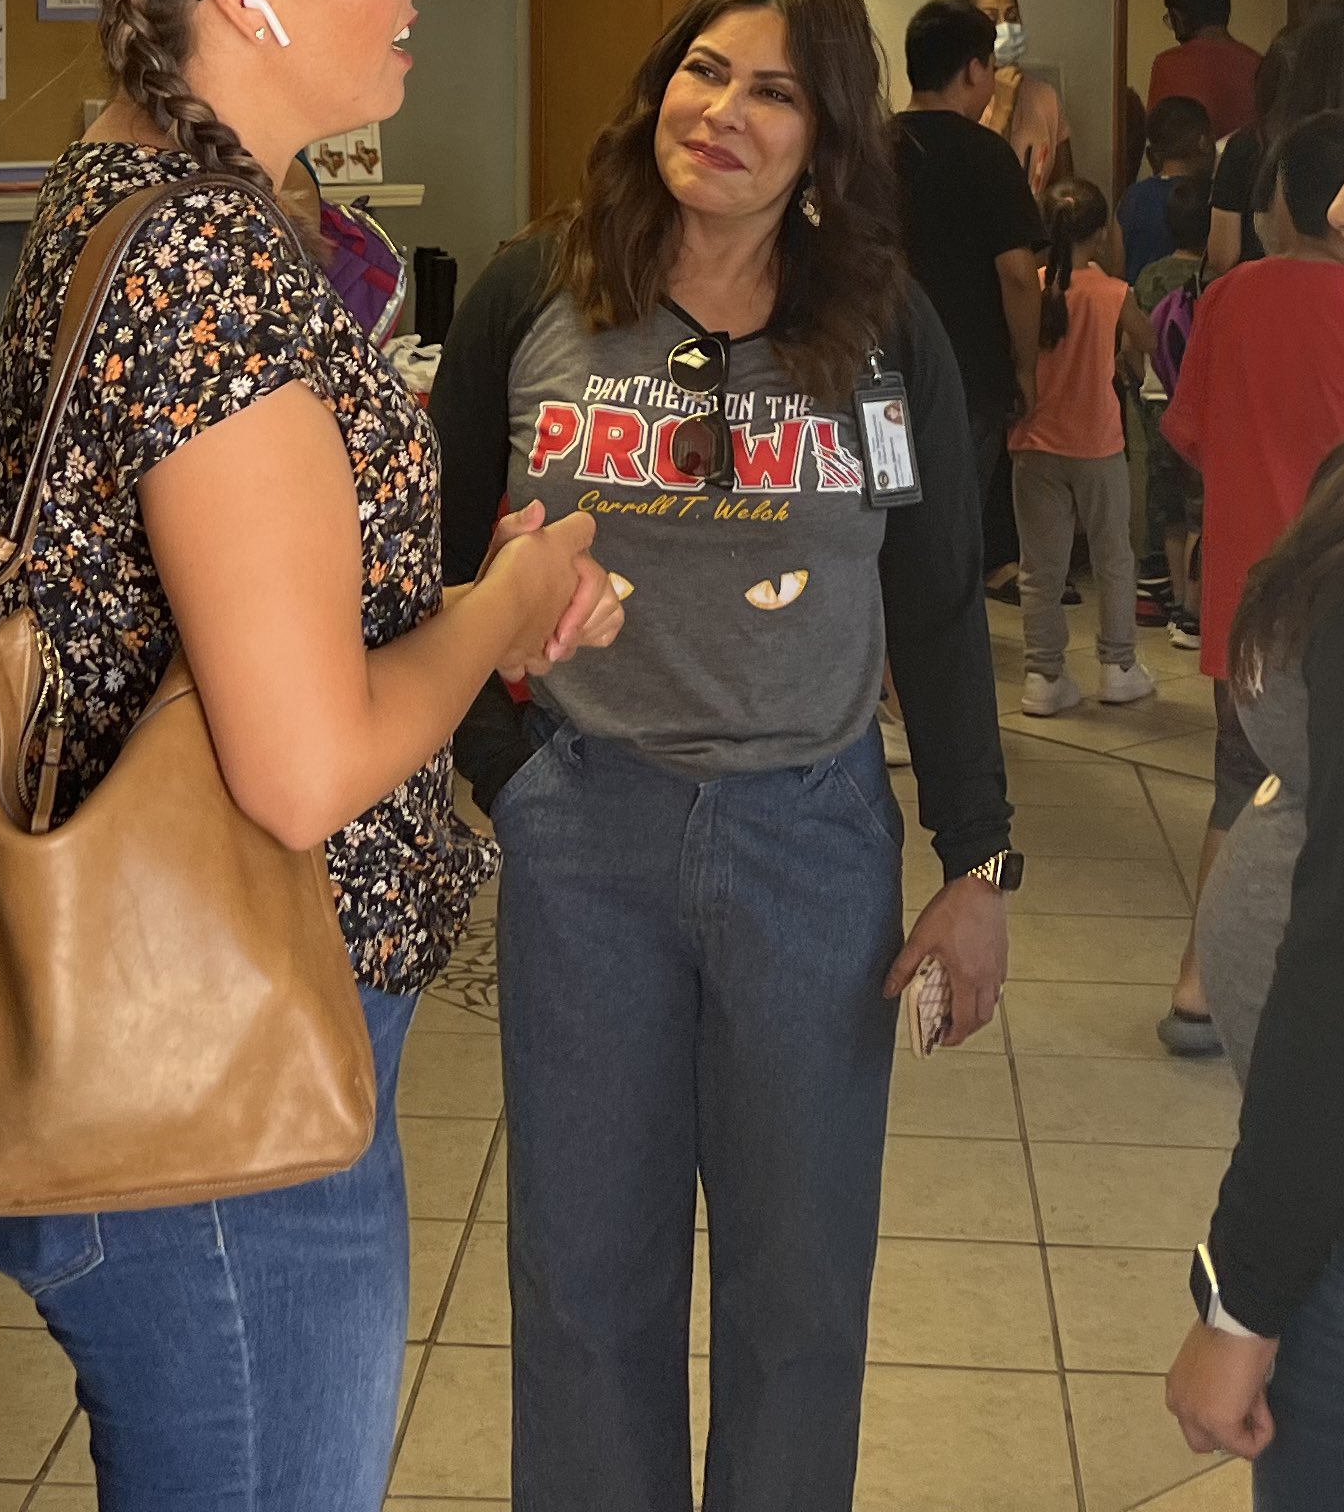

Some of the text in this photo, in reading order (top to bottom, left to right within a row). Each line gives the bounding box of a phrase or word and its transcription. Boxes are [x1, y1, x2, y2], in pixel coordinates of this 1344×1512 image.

[724, 391, 756, 421] ON
[765, 393, 815, 420] THE
[577, 489, 678, 517] Carroll
[713, 496, 791, 522] Welch
